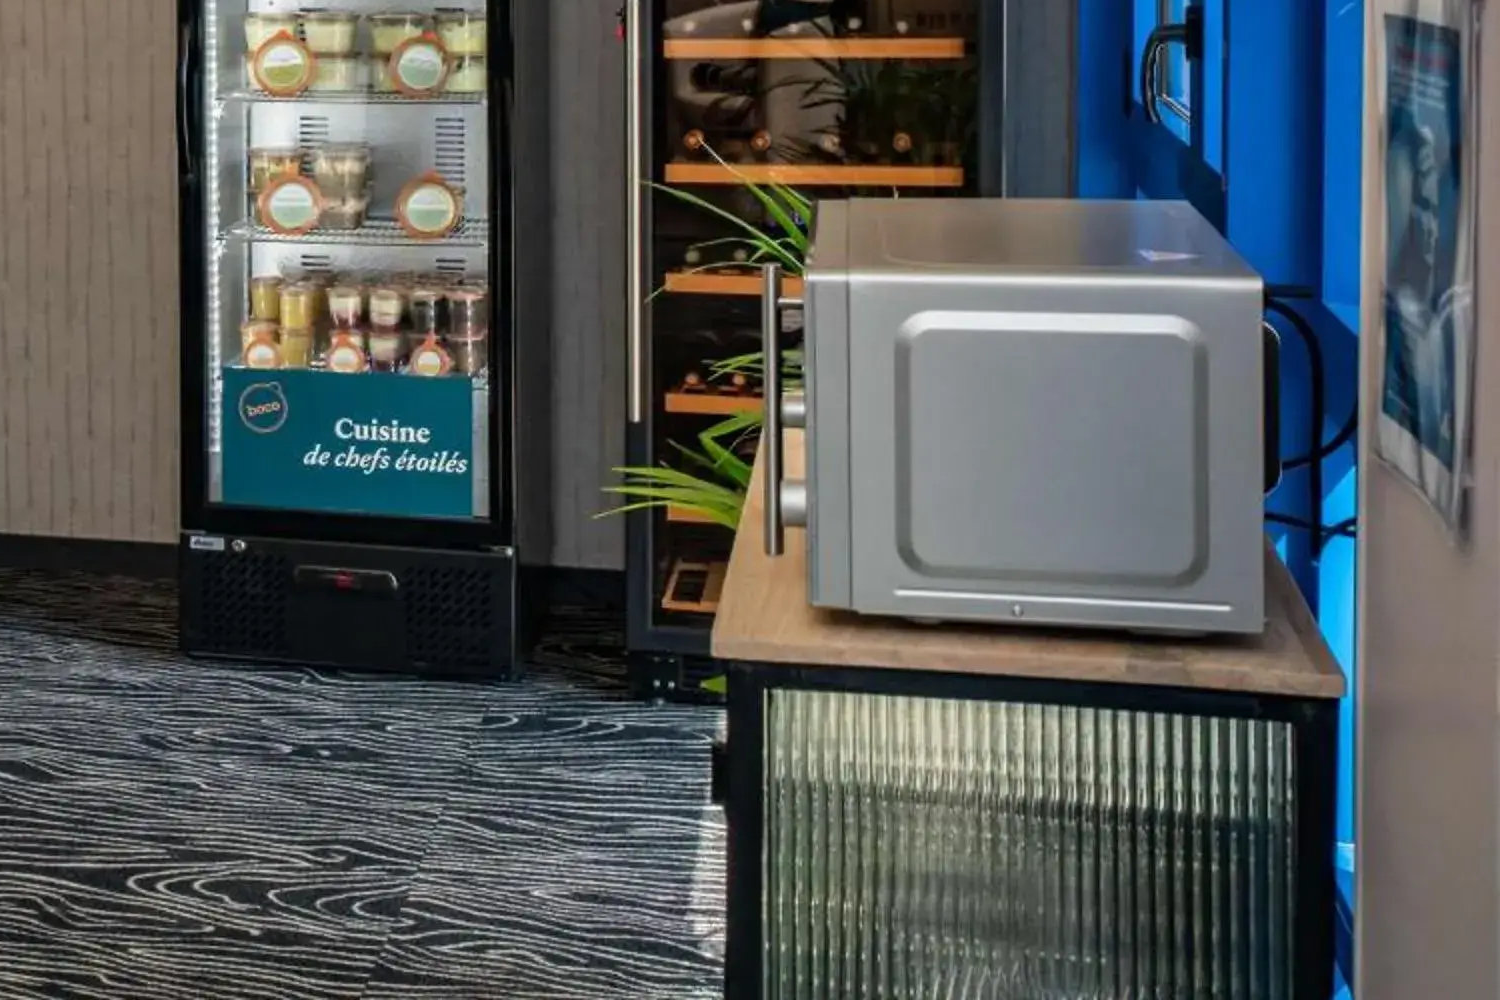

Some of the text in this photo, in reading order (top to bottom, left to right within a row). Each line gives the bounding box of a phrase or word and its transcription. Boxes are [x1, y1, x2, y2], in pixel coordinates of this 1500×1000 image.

[334, 417, 431, 444] Cuisine
[303, 443, 469, 475] de chefs étoilés
